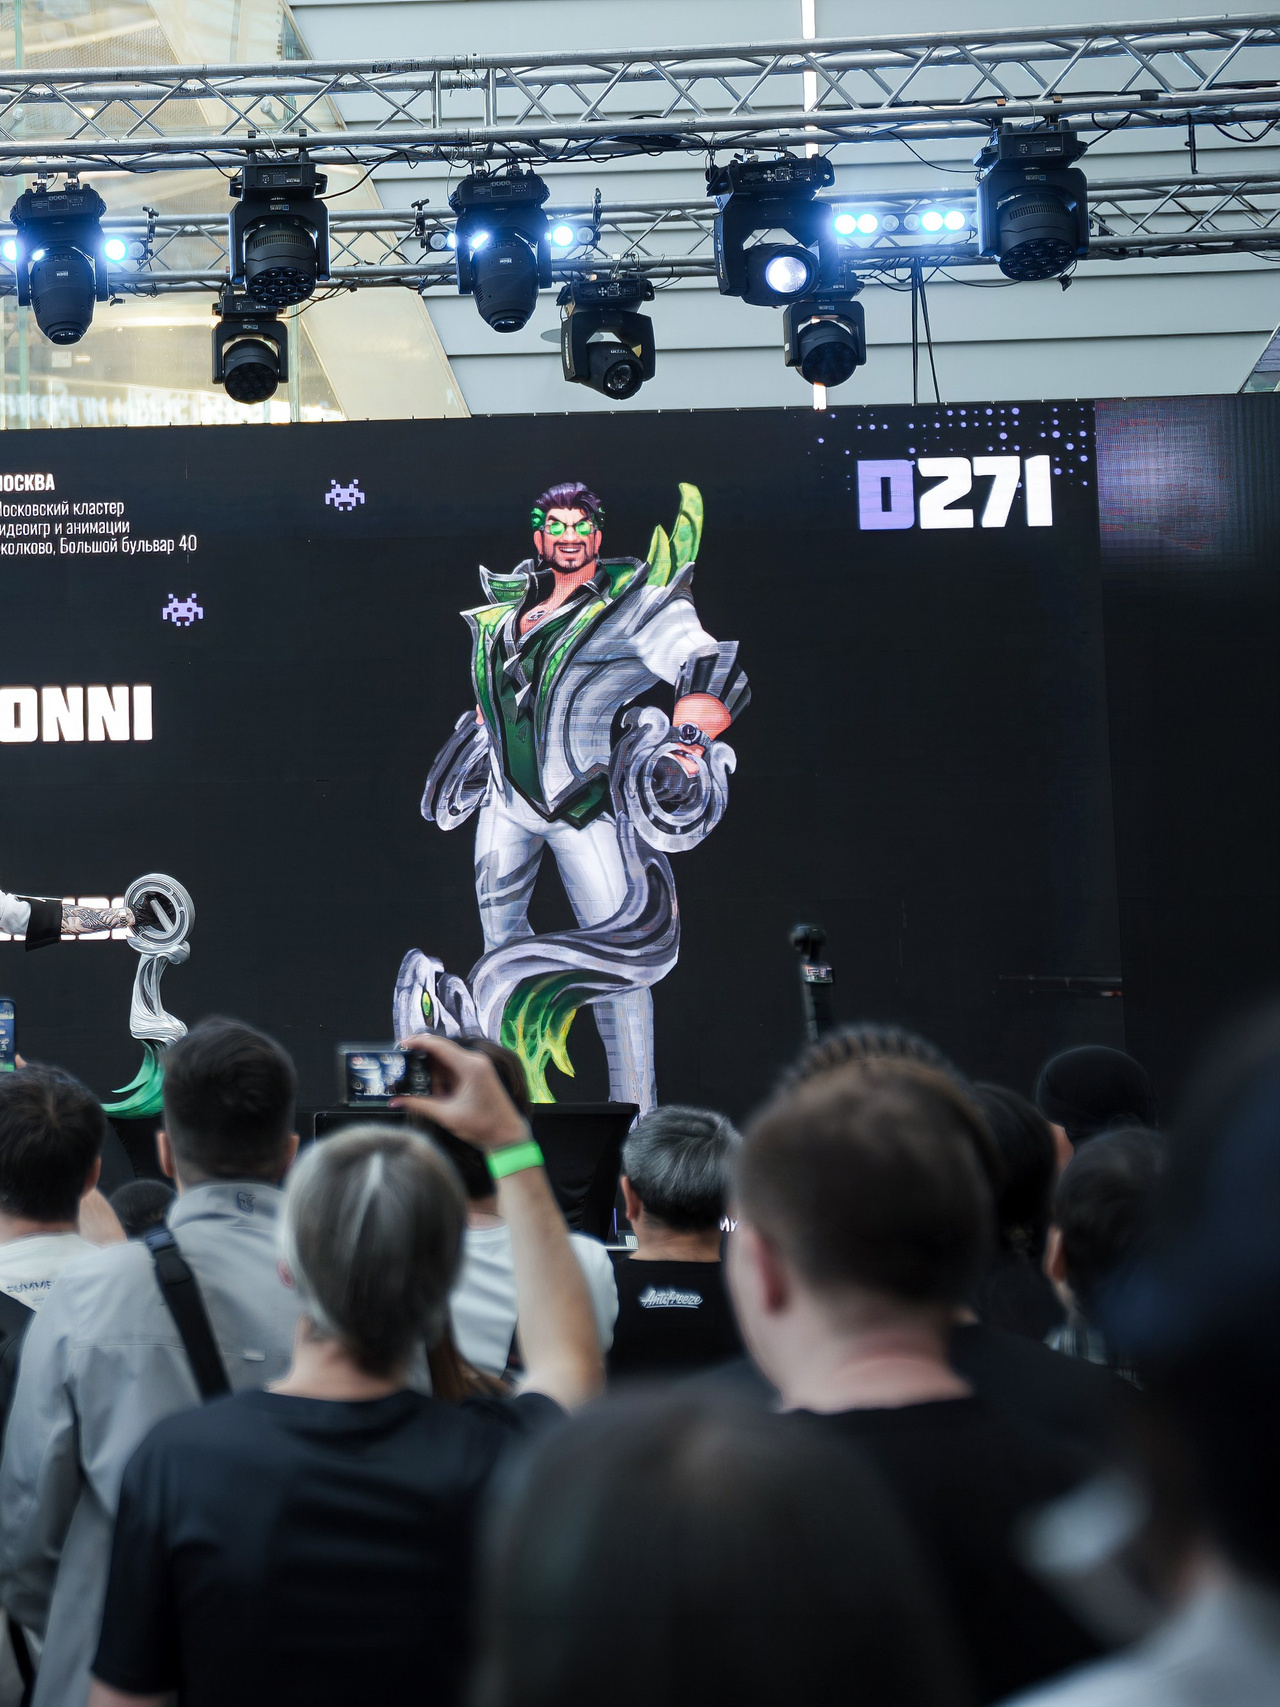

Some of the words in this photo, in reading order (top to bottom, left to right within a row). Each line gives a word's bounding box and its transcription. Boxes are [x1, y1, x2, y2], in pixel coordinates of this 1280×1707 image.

[857, 455, 1053, 530] D271
[73, 501, 125, 517] кластер
[54, 523, 63, 535] и
[66, 520, 130, 536] анимации
[59, 537, 118, 555] Большой
[121, 536, 175, 555] бульвар
[178, 535, 197, 552] 40
